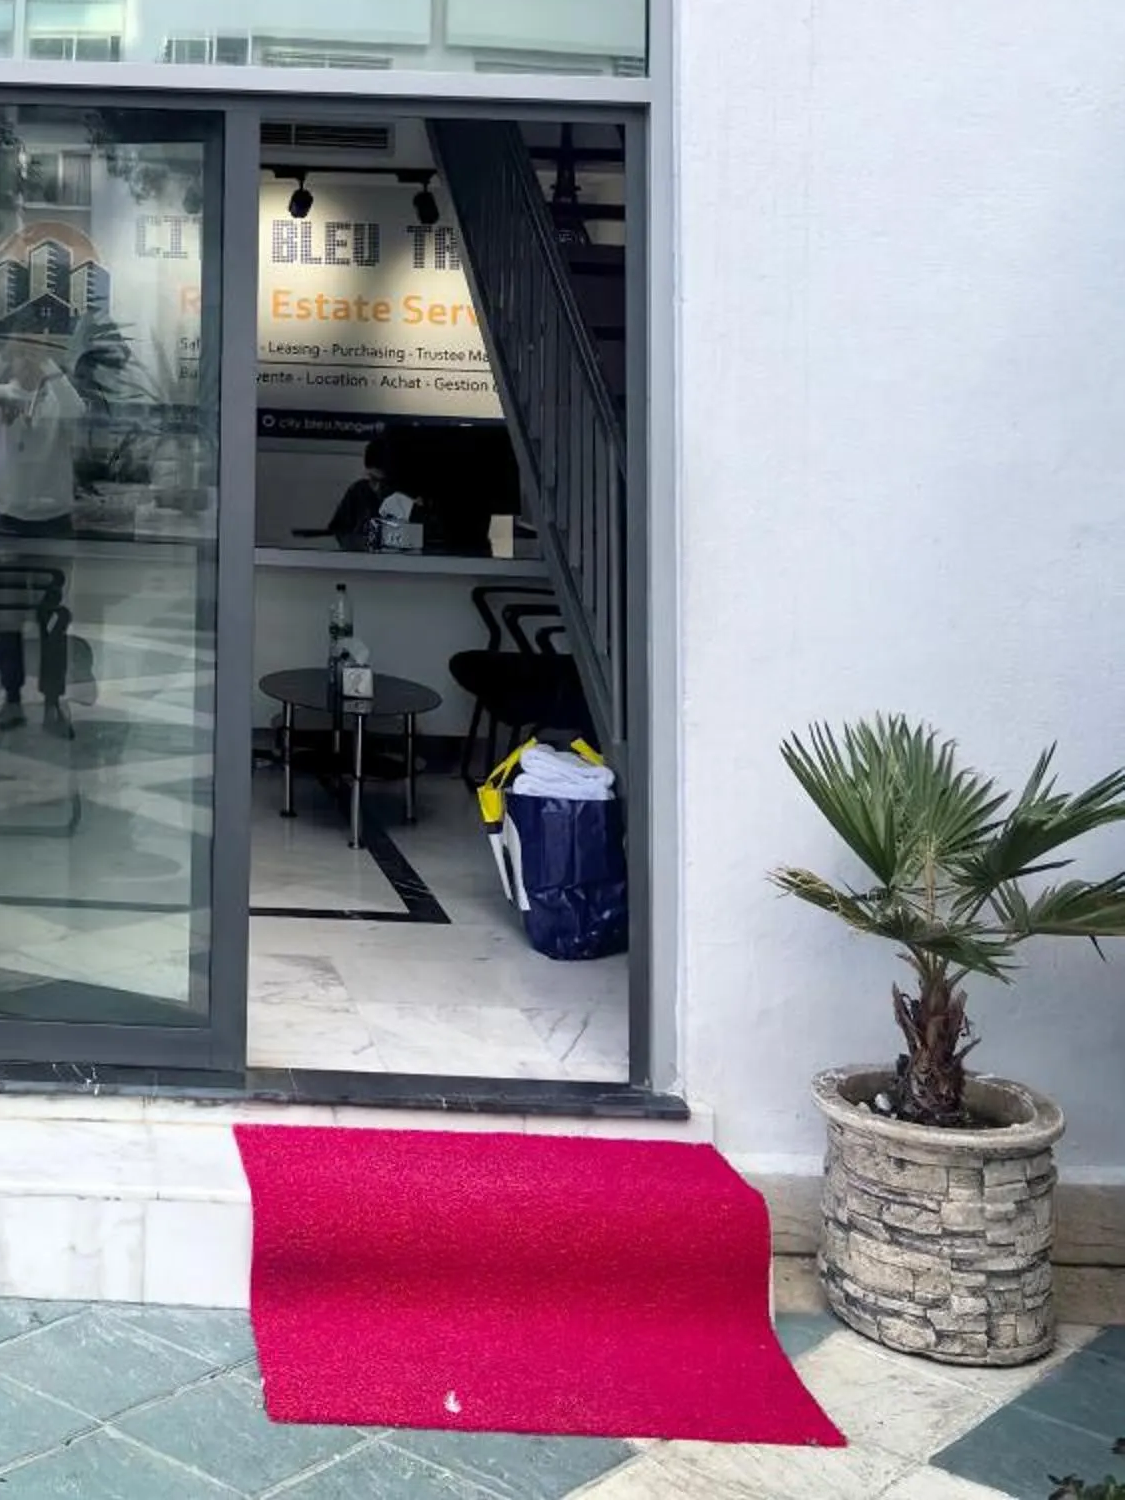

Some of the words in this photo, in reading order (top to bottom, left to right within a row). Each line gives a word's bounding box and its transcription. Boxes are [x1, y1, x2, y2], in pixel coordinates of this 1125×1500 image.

[271, 219, 380, 267] BLEU
[271, 290, 392, 323] Estate
[268, 341, 320, 358] Leasing
[332, 343, 405, 362] Purchasing
[415, 347, 466, 361] Trustee
[306, 371, 369, 387] Location
[380, 375, 422, 389] Achat
[434, 377, 489, 392] Gestion
